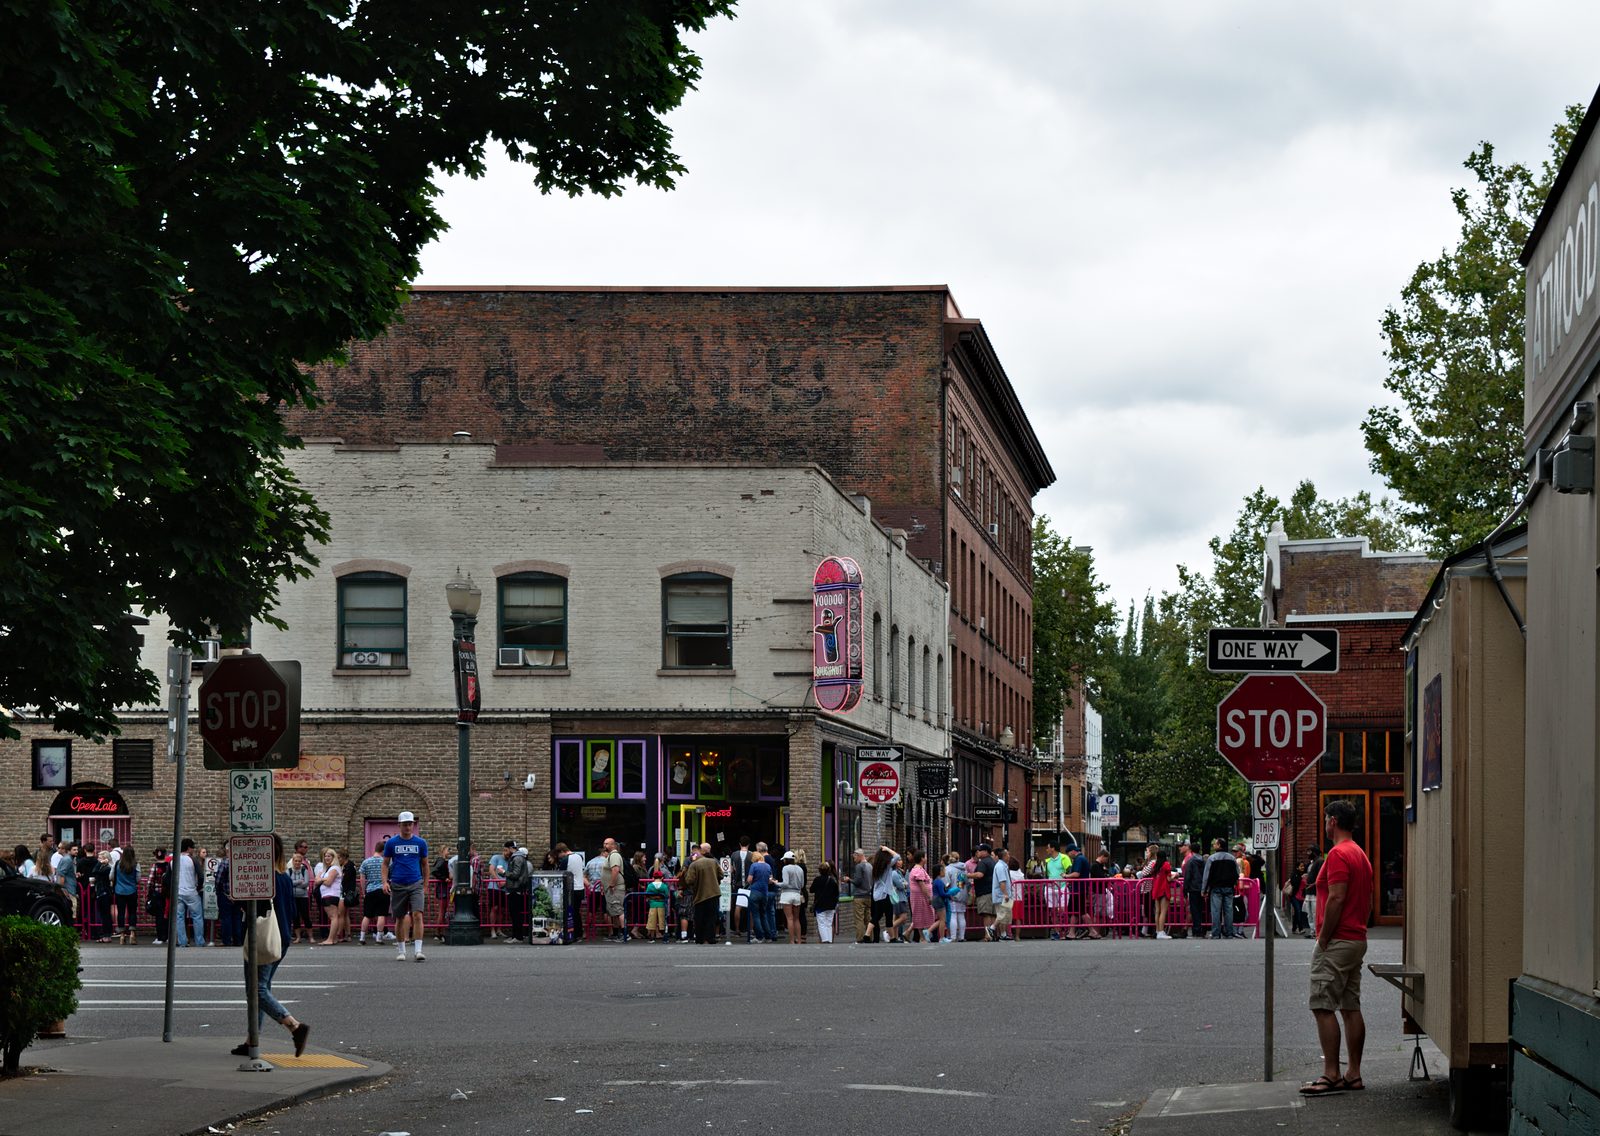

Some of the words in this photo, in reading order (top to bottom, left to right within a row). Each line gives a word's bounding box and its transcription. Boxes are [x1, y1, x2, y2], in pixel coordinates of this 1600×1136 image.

[1532, 180, 1598, 384] ATWOOD
[815, 593, 843, 607] VOODOO
[1222, 642, 1257, 658] ONE
[1263, 642, 1299, 658] WAY
[815, 664, 843, 677] DOUGHNUT
[206, 689, 281, 731] STOP
[1224, 709, 1318, 749] STOP
[867, 788, 891, 796] ENTER
[71, 795, 96, 812] Open
[95, 797, 118, 811] Late
[243, 796, 260, 804] PAY
[246, 804, 258, 812] TO
[240, 812, 263, 820] PARK
[1259, 823, 1274, 833] THIS
[233, 839, 271, 847] RESERVED
[1255, 833, 1276, 844] BLOCK
[238, 865, 267, 873] PERMIT
